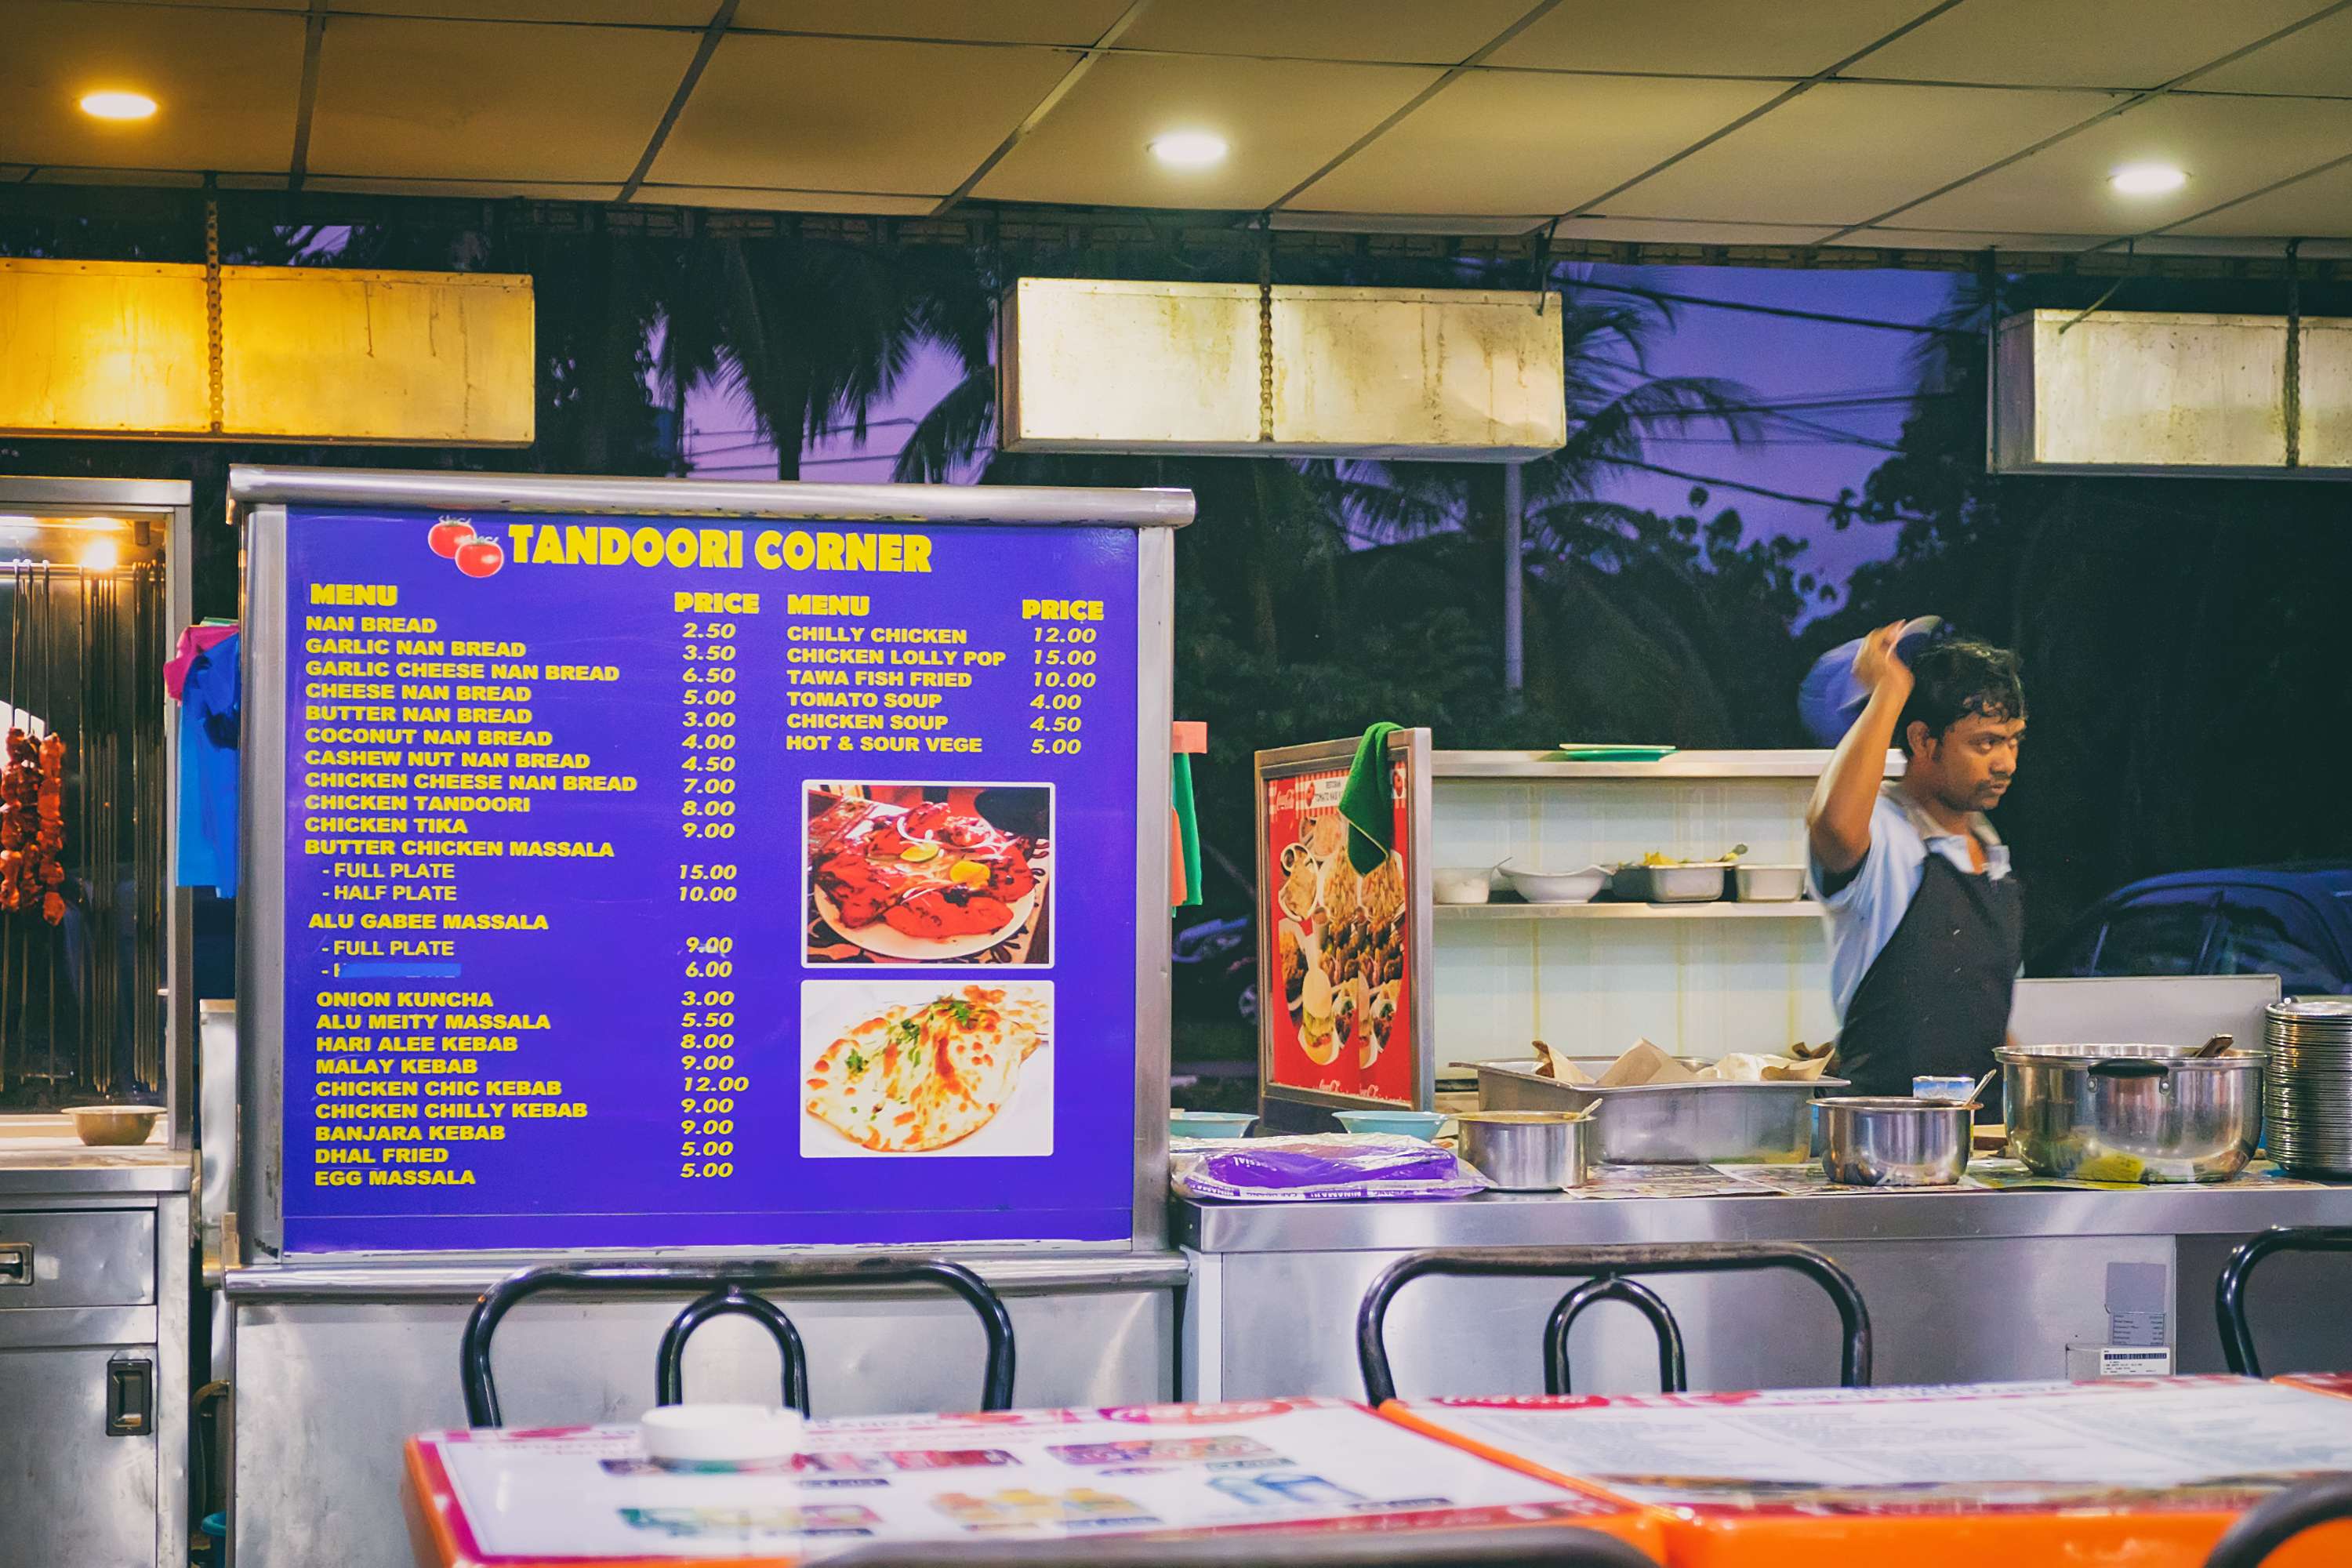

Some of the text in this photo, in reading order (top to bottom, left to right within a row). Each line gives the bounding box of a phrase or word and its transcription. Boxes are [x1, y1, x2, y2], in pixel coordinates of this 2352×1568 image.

[507, 523, 932, 573] TANDOORI CORNER
[310, 583, 398, 607] MENU
[673, 591, 760, 615] PRICE
[787, 593, 870, 617] MENU
[1022, 599, 1105, 622] PRICE
[306, 615, 437, 634] NAN BREAD
[683, 622, 736, 639] 2.50
[786, 626, 967, 644] CHILLY CHICKEN
[1035, 626, 1097, 644] 12.00
[305, 637, 527, 658] GARLIC NAN BREAD
[682, 644, 736, 661] 3.50
[786, 648, 1007, 666] CHICKEN LOLLY POP
[1034, 649, 1097, 666] 15.00
[305, 660, 619, 681] GARLIC CHEESE NAN BREAD
[682, 667, 736, 684] 6.50
[786, 669, 972, 688] TAWA FISH FRIED
[1034, 671, 1097, 688] 10.00
[305, 682, 532, 702] CHEESE NAN BREAD
[683, 689, 736, 706] 5.00
[786, 691, 942, 709] TOMATO SOUP
[1030, 693, 1082, 710] 4.00
[305, 705, 533, 724] BUTTER NAN BREAD
[682, 711, 736, 728] 3.00
[786, 713, 949, 731] CHICKEN SOUP
[1029, 716, 1082, 733] 4.50
[305, 727, 553, 746] COCONUT NAN BREAD
[681, 734, 736, 750] 4.00
[786, 735, 982, 753] HOT & SOUR VEGE
[1031, 738, 1082, 755] 5.00
[304, 750, 590, 769] CASHEW NUT NAN BREAD
[681, 755, 735, 772] 4.50
[304, 771, 637, 792] CHICKEN CHEESE NAN BREAD
[684, 778, 735, 794] 7.00
[304, 794, 531, 813] CHICKEN TANDOORI
[681, 800, 735, 816] 8.00
[304, 816, 469, 834] CHICKEN TIKA
[682, 822, 735, 839] 9.00
[304, 839, 615, 858] BUTTER CHICKEN MASSALA
[334, 862, 385, 878] FULL
[390, 862, 455, 879] PLATE
[680, 865, 737, 880] 15.00
[334, 884, 387, 901] HALF
[392, 884, 457, 902] PLATE
[680, 886, 737, 902] 10.00
[308, 913, 549, 930] ALU GABEE MASSALA
[333, 940, 385, 956] FULL
[390, 940, 454, 956] PLATE
[686, 937, 733, 955] 9.00
[685, 960, 733, 978] 6.00
[316, 991, 494, 1007] ONION KUNCHA
[681, 990, 735, 1006] 3.00
[316, 1014, 551, 1030] ALU MEITY MASSALA
[681, 1011, 735, 1028] 5.50
[316, 1036, 518, 1052] HARI ALEE KEBAB
[681, 1033, 735, 1049] 8.00
[316, 1058, 477, 1074] MALAY KEBAB
[681, 1054, 735, 1071] 9.00
[315, 1080, 562, 1097] CHICKEN CHIC KEBAB
[684, 1076, 750, 1092] 12.00
[315, 1102, 588, 1120] CHICKEN CHILLY KEBAB
[681, 1098, 734, 1114] 9.00
[315, 1125, 506, 1142] BANJARA KEBAB
[681, 1119, 734, 1135] 9.00
[315, 1147, 449, 1164] DHAL FRIED
[681, 1141, 734, 1156] 5.00
[314, 1169, 476, 1186] EGG MASSALA
[681, 1162, 734, 1178] 5.00
